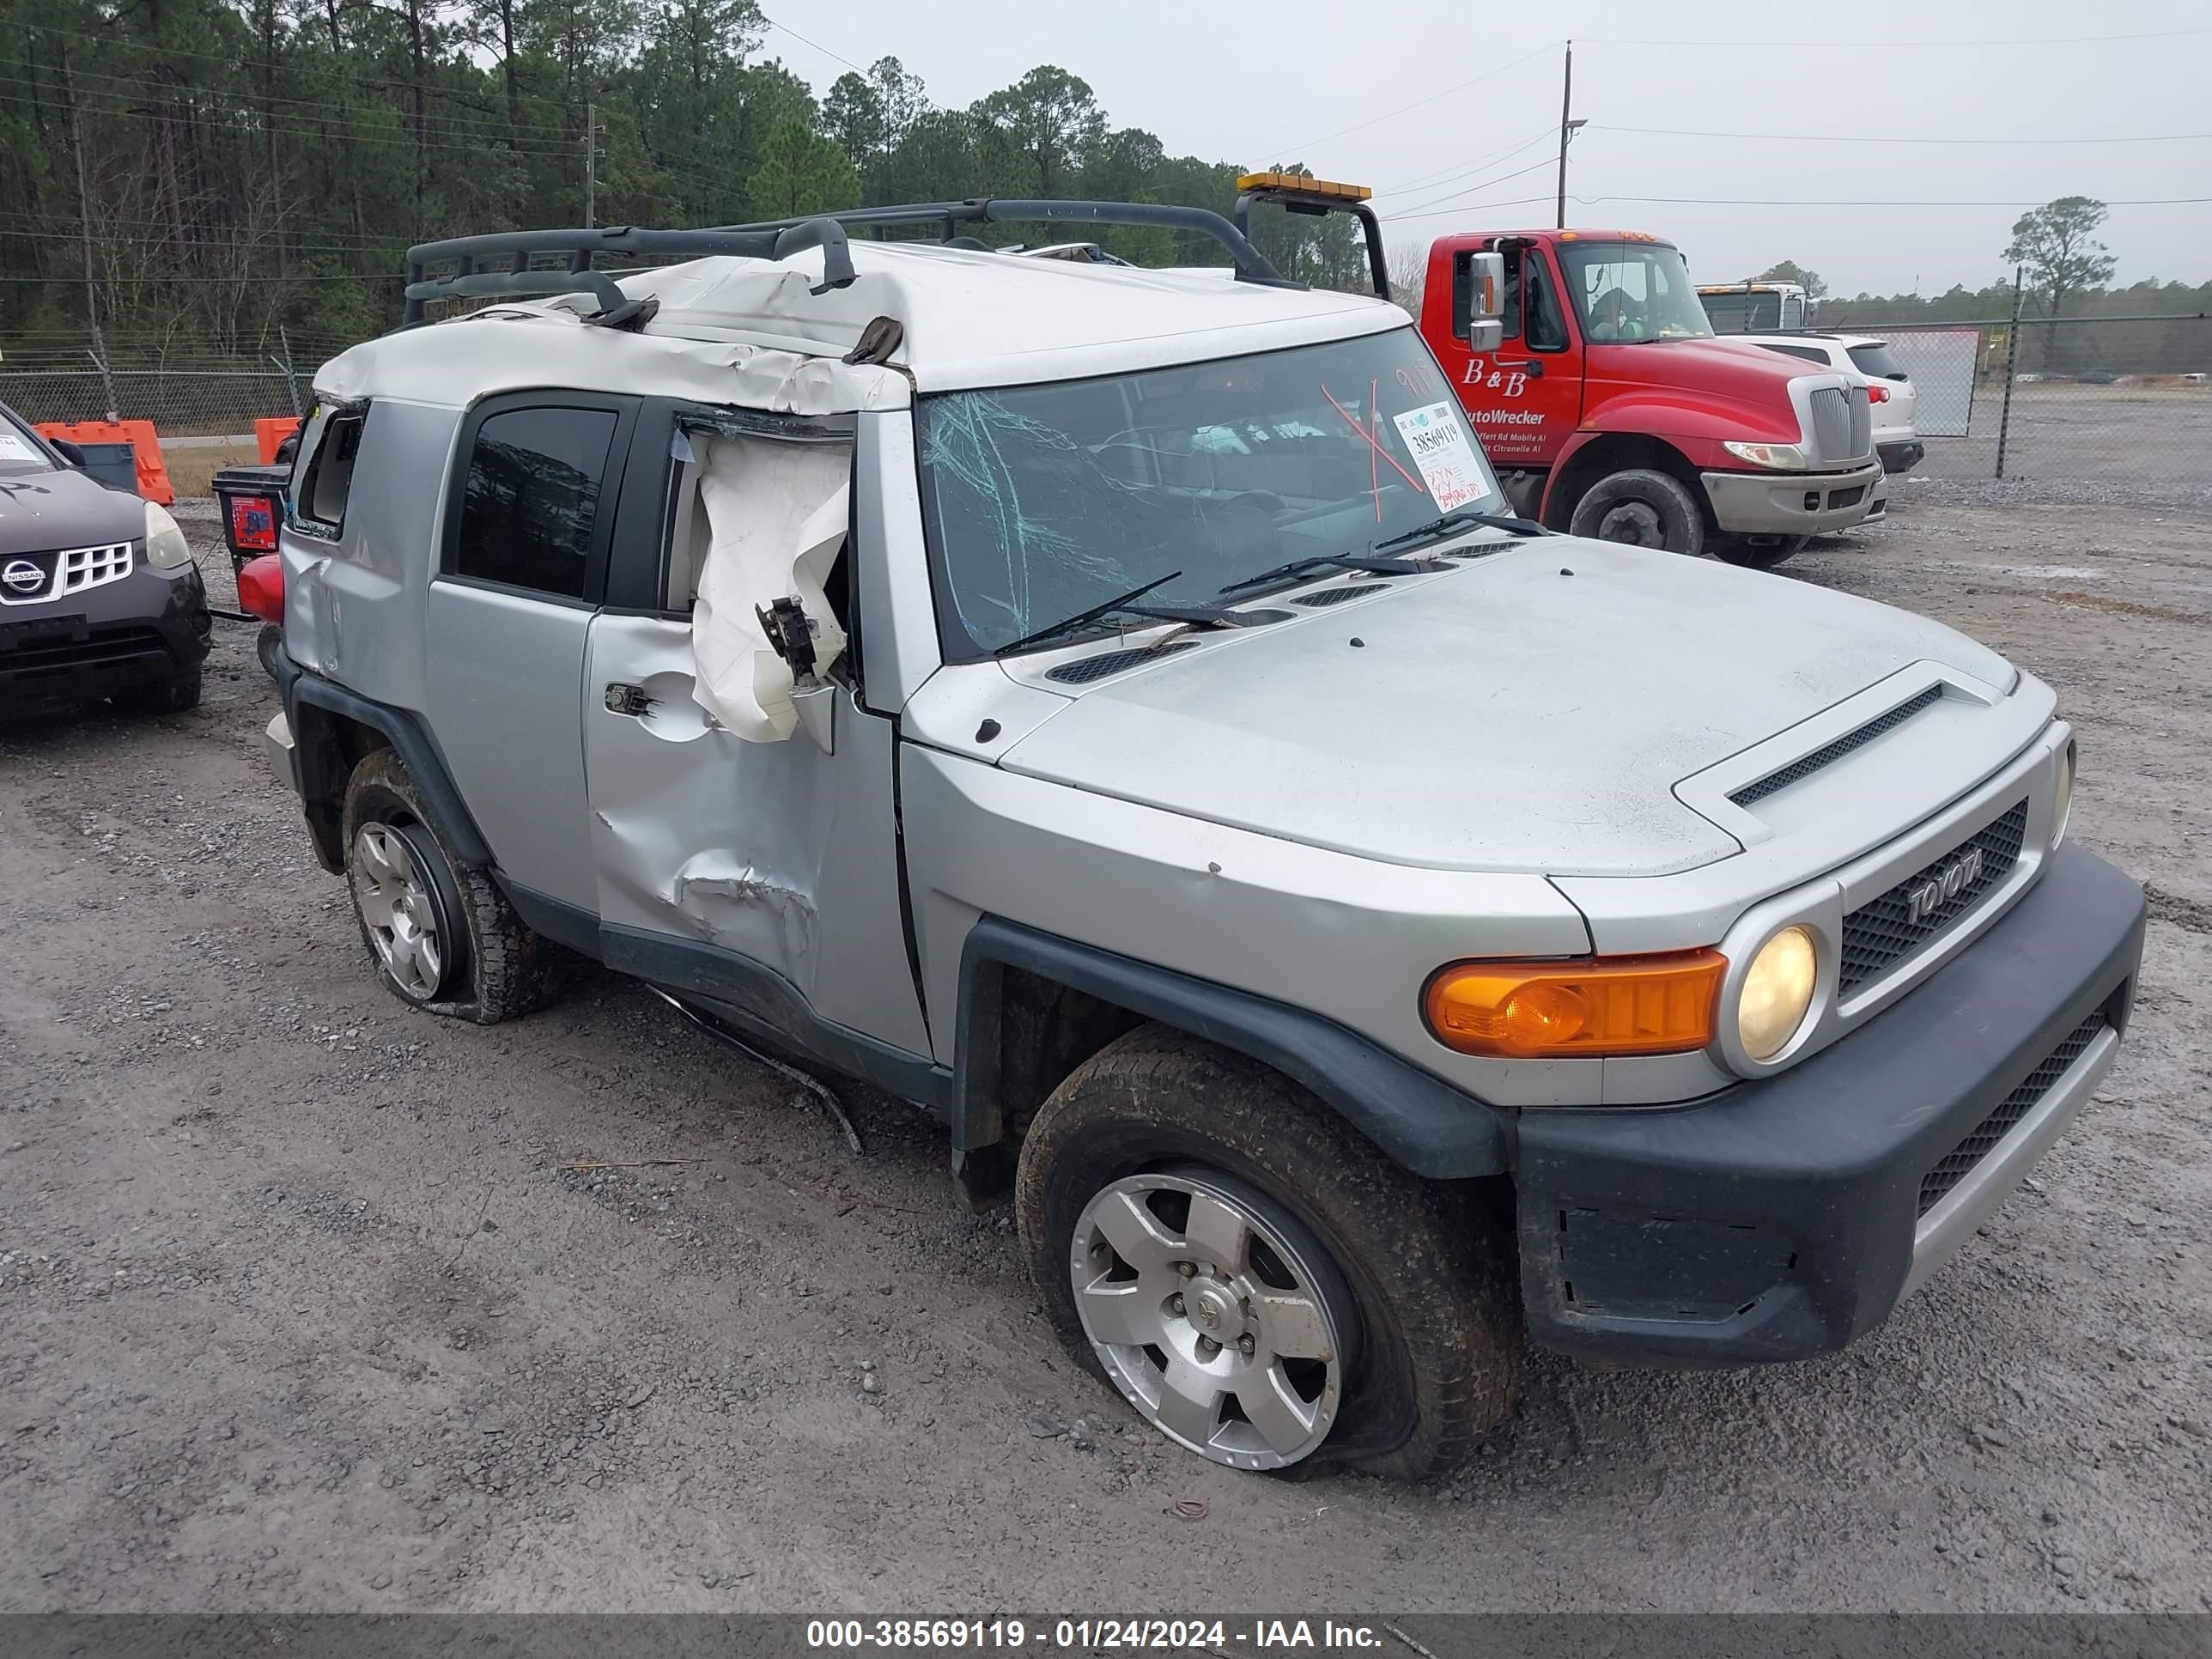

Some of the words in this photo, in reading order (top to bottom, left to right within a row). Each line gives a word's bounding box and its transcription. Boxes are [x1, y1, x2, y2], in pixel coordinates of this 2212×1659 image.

[1462, 358, 1484, 384] B
[1486, 371, 1502, 388] &
[1502, 372, 1527, 398] B
[1467, 409, 1545, 425] utoWrecker
[1413, 422, 1459, 454] 38569119
[1510, 433, 1536, 441] Mobile
[1493, 444, 1531, 453] Citronelle
[8, 572, 42, 580] NISSAN
[1908, 848, 1984, 924] TOYOTA
